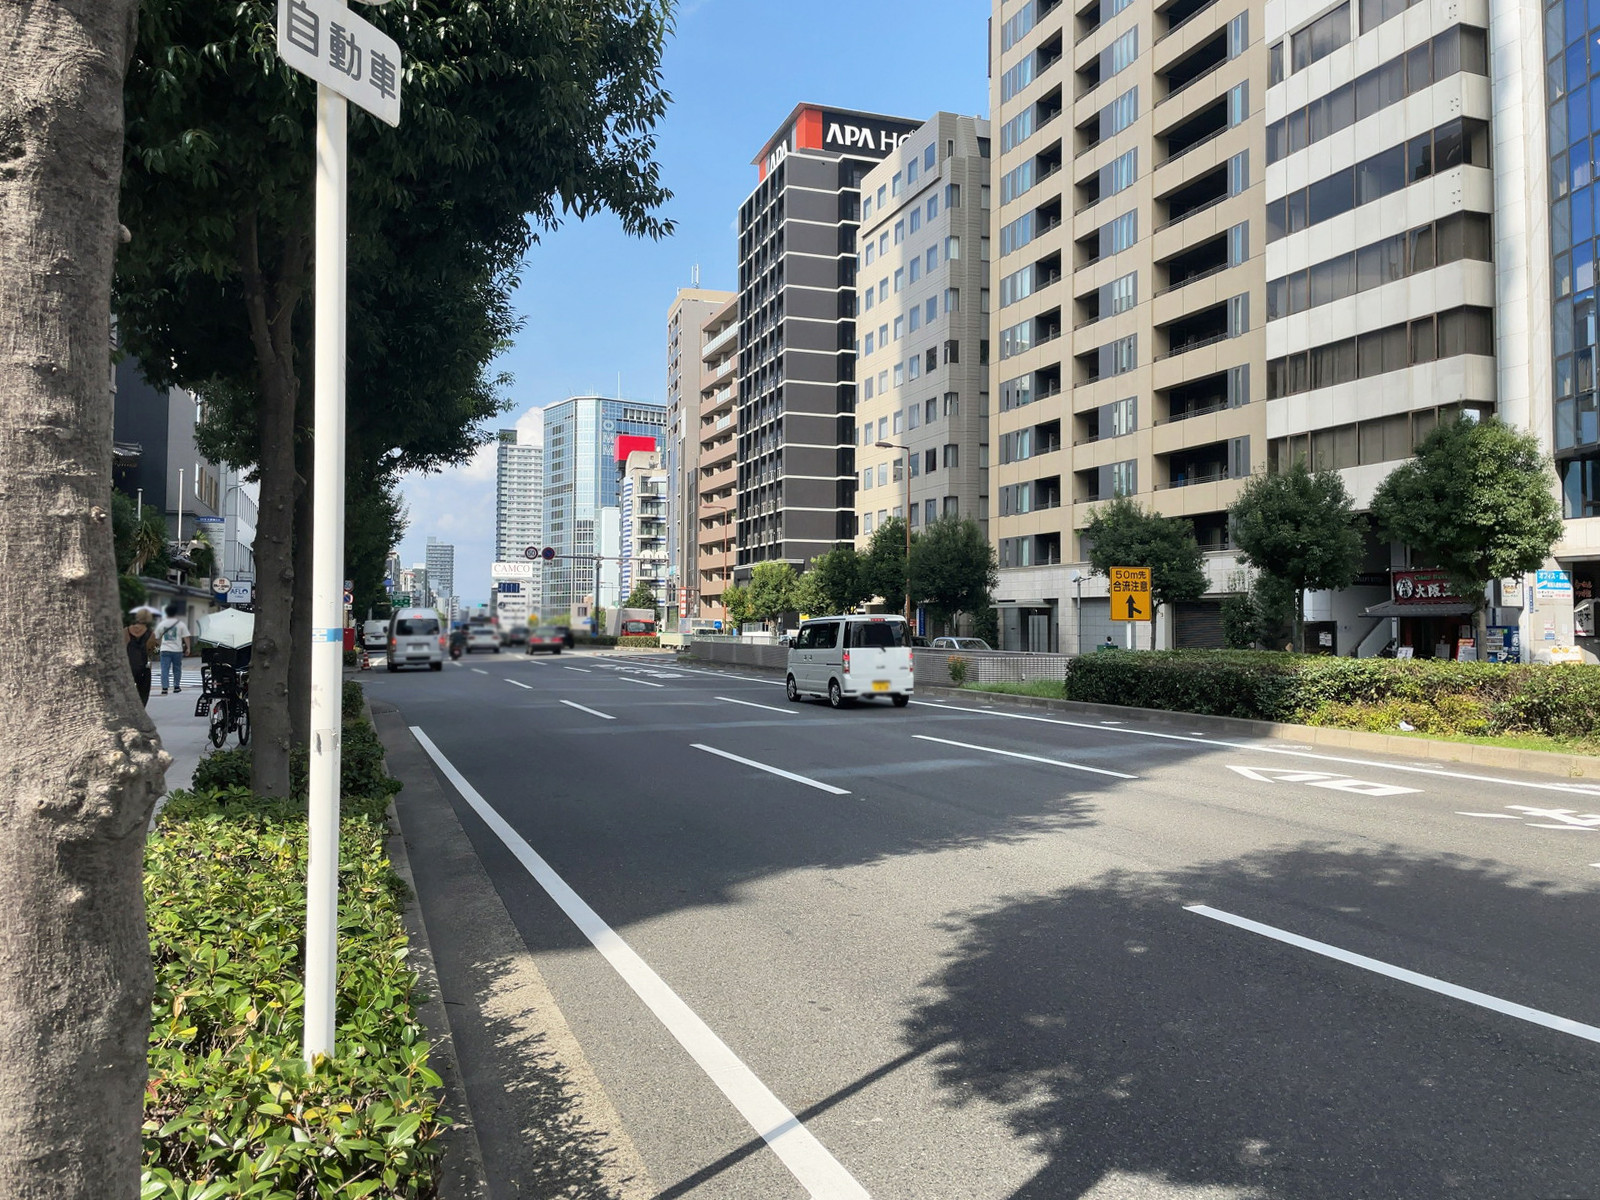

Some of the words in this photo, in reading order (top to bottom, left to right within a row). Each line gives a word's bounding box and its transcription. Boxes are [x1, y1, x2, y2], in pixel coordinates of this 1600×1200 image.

[286, 0, 396, 100] 自動車
[826, 123, 875, 149] APA
[494, 564, 530, 573] CAMCO
[1115, 570, 1147, 580] 50m先
[1112, 580, 1148, 592] 合流注意
